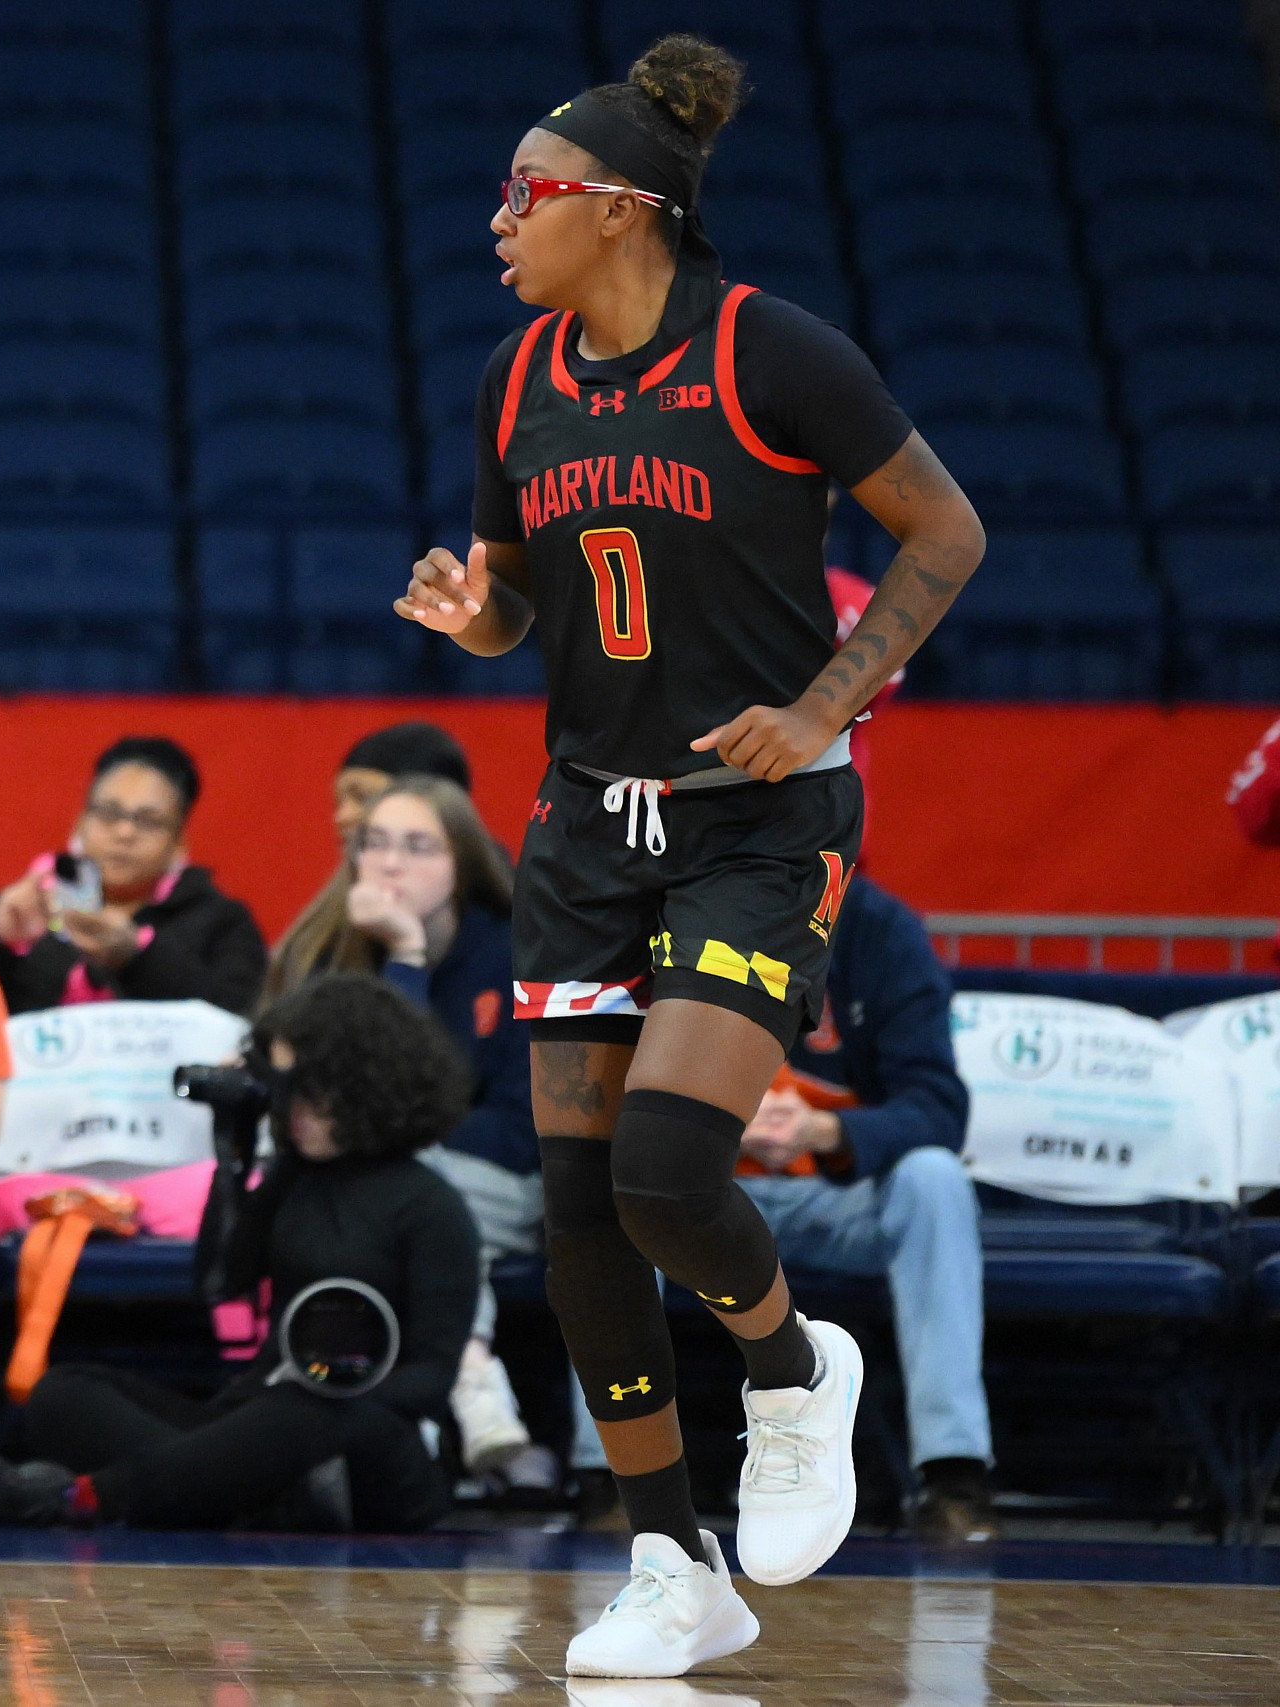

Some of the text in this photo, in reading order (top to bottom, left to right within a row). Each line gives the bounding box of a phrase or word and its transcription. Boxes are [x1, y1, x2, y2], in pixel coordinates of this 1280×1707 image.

[520, 454, 712, 540] MARYLAND
[579, 527, 651, 661] 0
[1093, 1140, 1110, 1164] A
